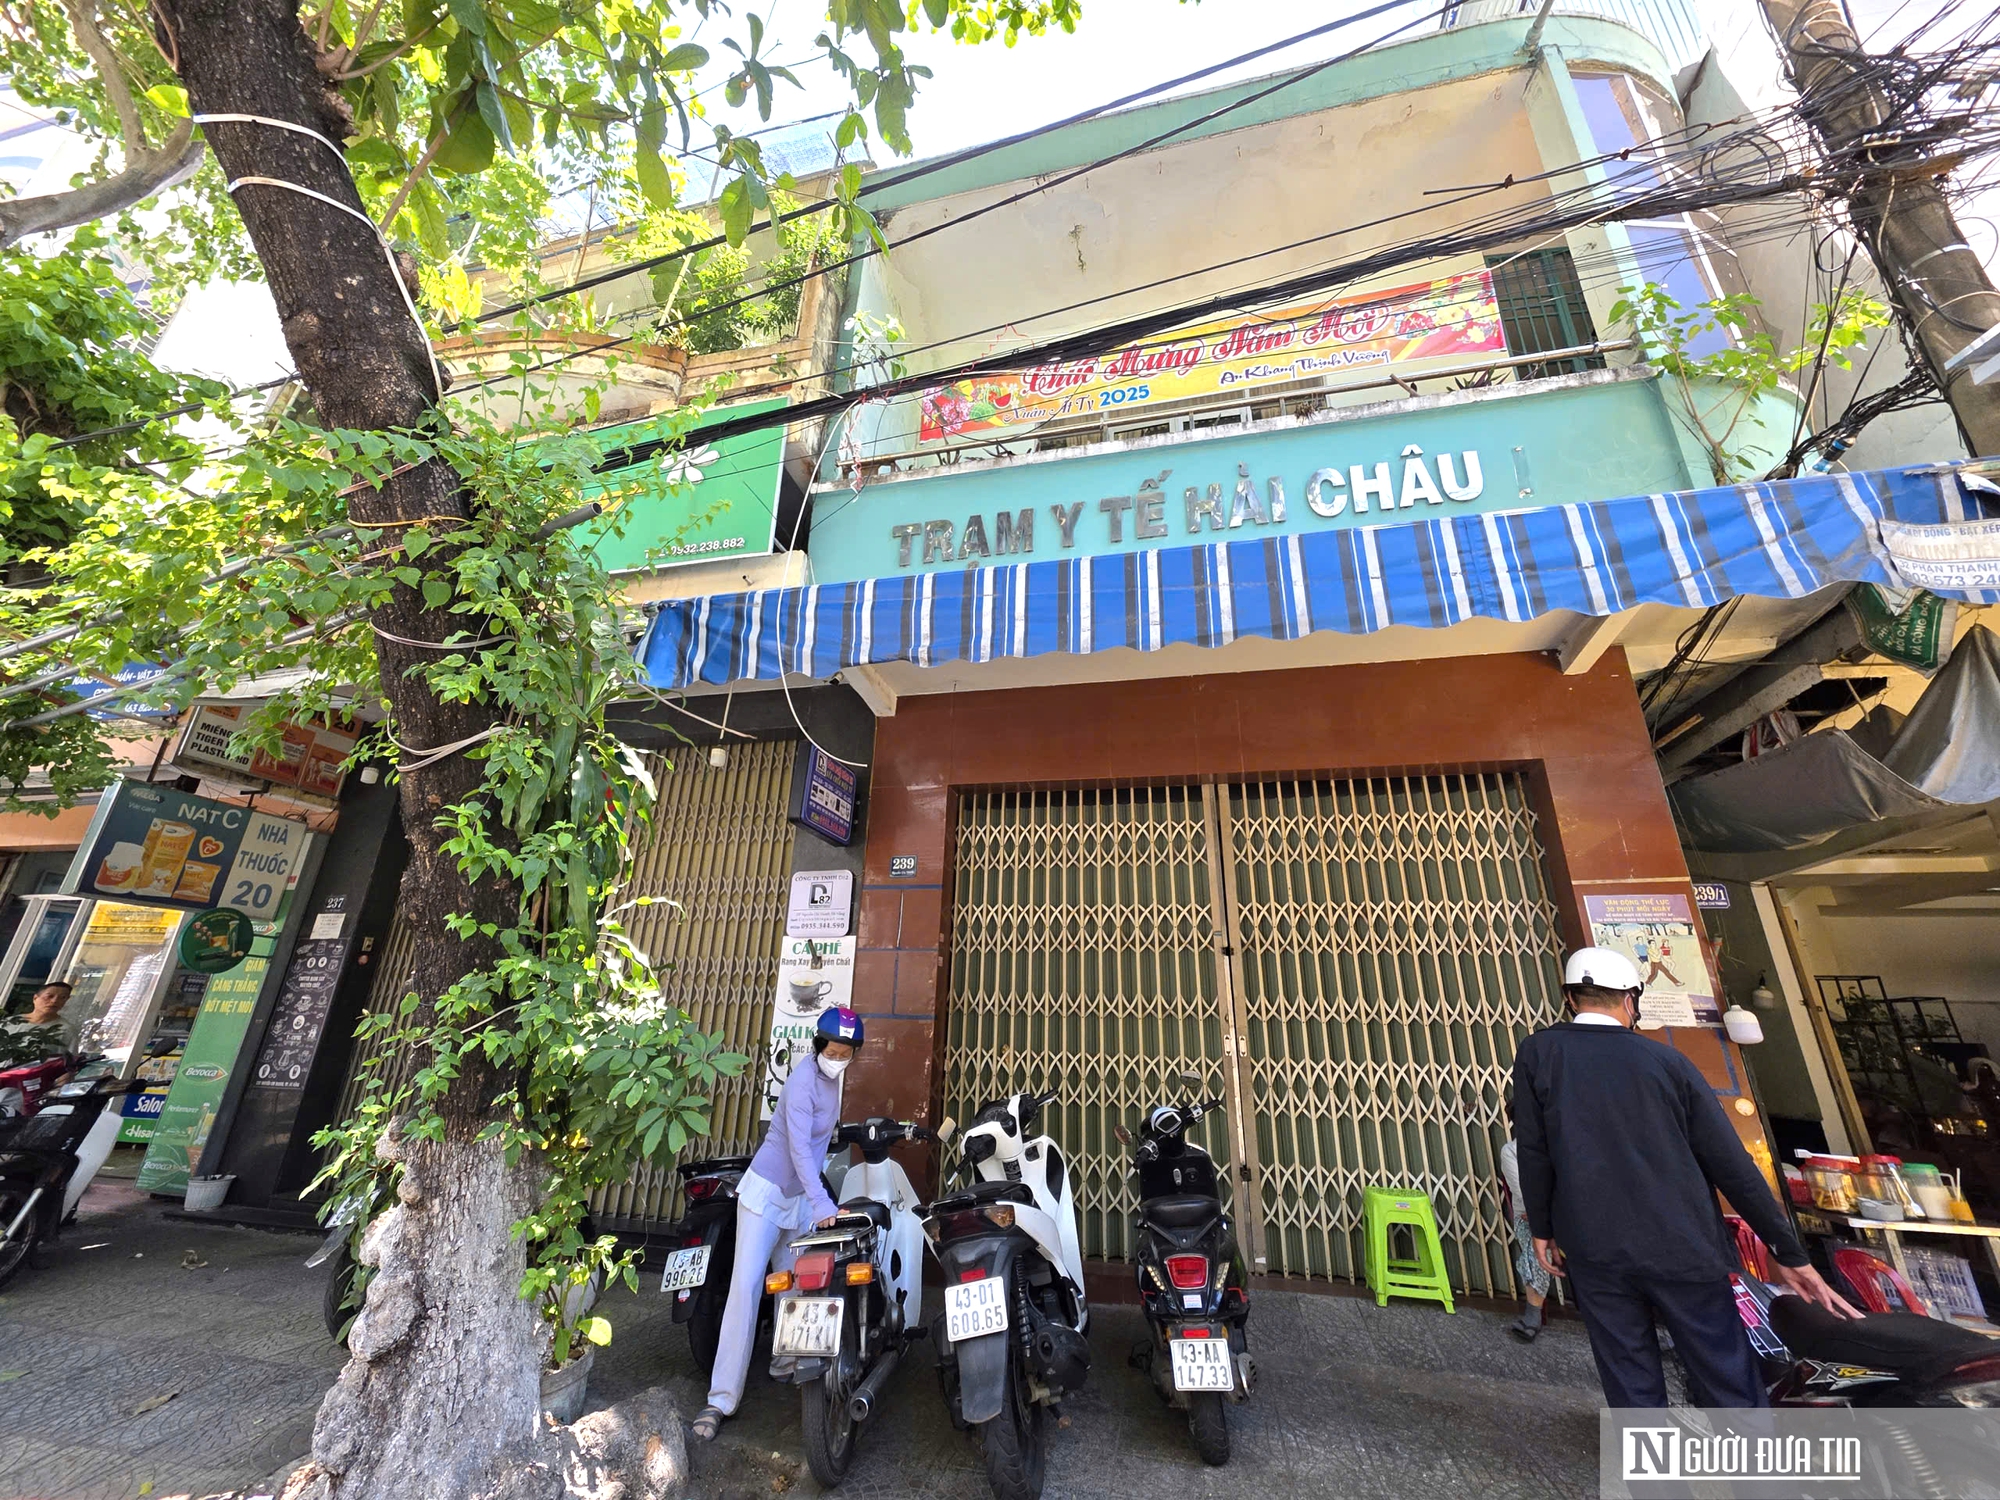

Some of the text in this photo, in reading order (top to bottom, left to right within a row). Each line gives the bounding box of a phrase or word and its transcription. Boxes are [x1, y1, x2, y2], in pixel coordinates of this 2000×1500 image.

[1212, 320, 1297, 360] Năm
[1220, 371, 1243, 385] An
[1244, 362, 1296, 382] Khang
[1099, 384, 1151, 408] 2025
[892, 508, 1034, 569] TRẠM
[1051, 501, 1086, 547] Y
[1099, 469, 1172, 544] TẾ
[1306, 443, 1485, 517] CHÂU
[1947, 563, 1998, 573] THANH
[1934, 575, 1966, 587] 573
[1973, 574, 2000, 586] 24
[196, 732, 224, 747] TIGER
[178, 803, 221, 825] NAT
[257, 823, 289, 846] NHÀ
[239, 850, 289, 876] THUỐC
[892, 857, 915, 870] 239
[230, 880, 273, 909] 20
[326, 898, 345, 909] 237
[1693, 886, 1726, 901] 239/1
[781, 958, 797, 967] Rang
[798, 958, 810, 967] Xay
[185, 1067, 218, 1077] Berocca
[956, 1283, 994, 1309] 43-D1
[802, 1302, 820, 1325] 43
[951, 1305, 1004, 1336] 608.65
[1181, 1343, 1220, 1363] 43-AA
[1178, 1366, 1229, 1386] 147.33
